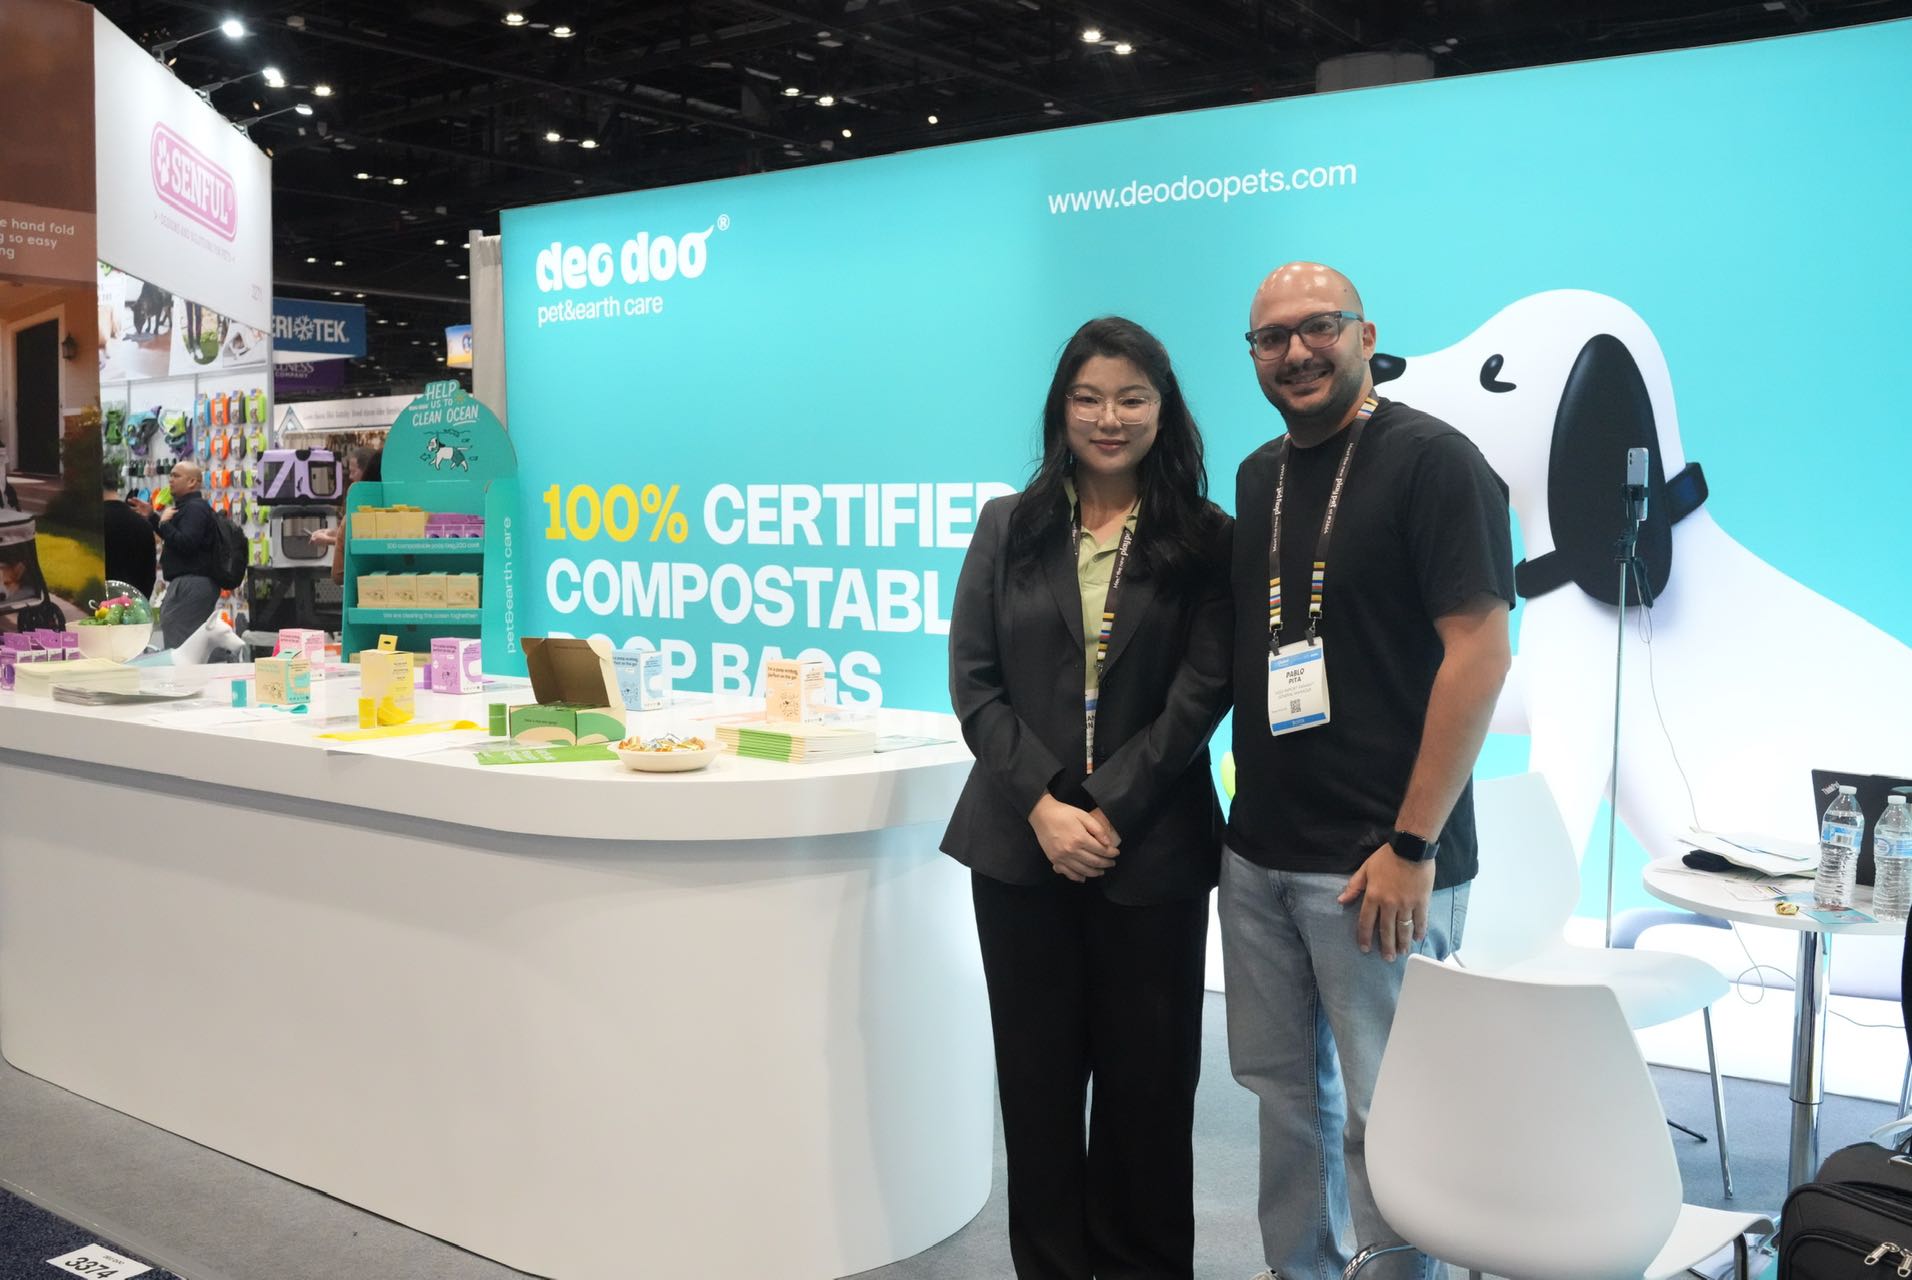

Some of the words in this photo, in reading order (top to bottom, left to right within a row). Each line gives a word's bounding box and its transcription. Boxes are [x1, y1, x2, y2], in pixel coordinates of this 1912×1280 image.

[172, 153, 229, 225] SENFUL
[1048, 163, 1358, 215] www.deodoopets.com
[11, 218, 45, 232] hand
[49, 222, 75, 236] fold
[9, 234, 24, 243] so
[27, 236, 58, 250] easy
[535, 241, 614, 292] deo
[620, 224, 715, 285] doo
[537, 296, 620, 328] pet&earth
[624, 292, 663, 317] care
[426, 381, 457, 400] HELP
[430, 400, 441, 408] US
[444, 398, 453, 406] TO
[412, 410, 442, 427] CLEAN
[446, 404, 479, 423] OCEAN
[1332, 478, 1344, 495] play
[543, 483, 689, 543] 100%
[1273, 499, 1282, 515] play
[503, 517, 512, 558] care
[1119, 540, 1131, 556] play
[545, 557, 952, 635] COMPOSTABL
[503, 562, 517, 653] pet&earth
[1285, 667, 1304, 679] PABLO
[1288, 676, 1302, 684] PITA
[65, 1257, 119, 1279] 3374
